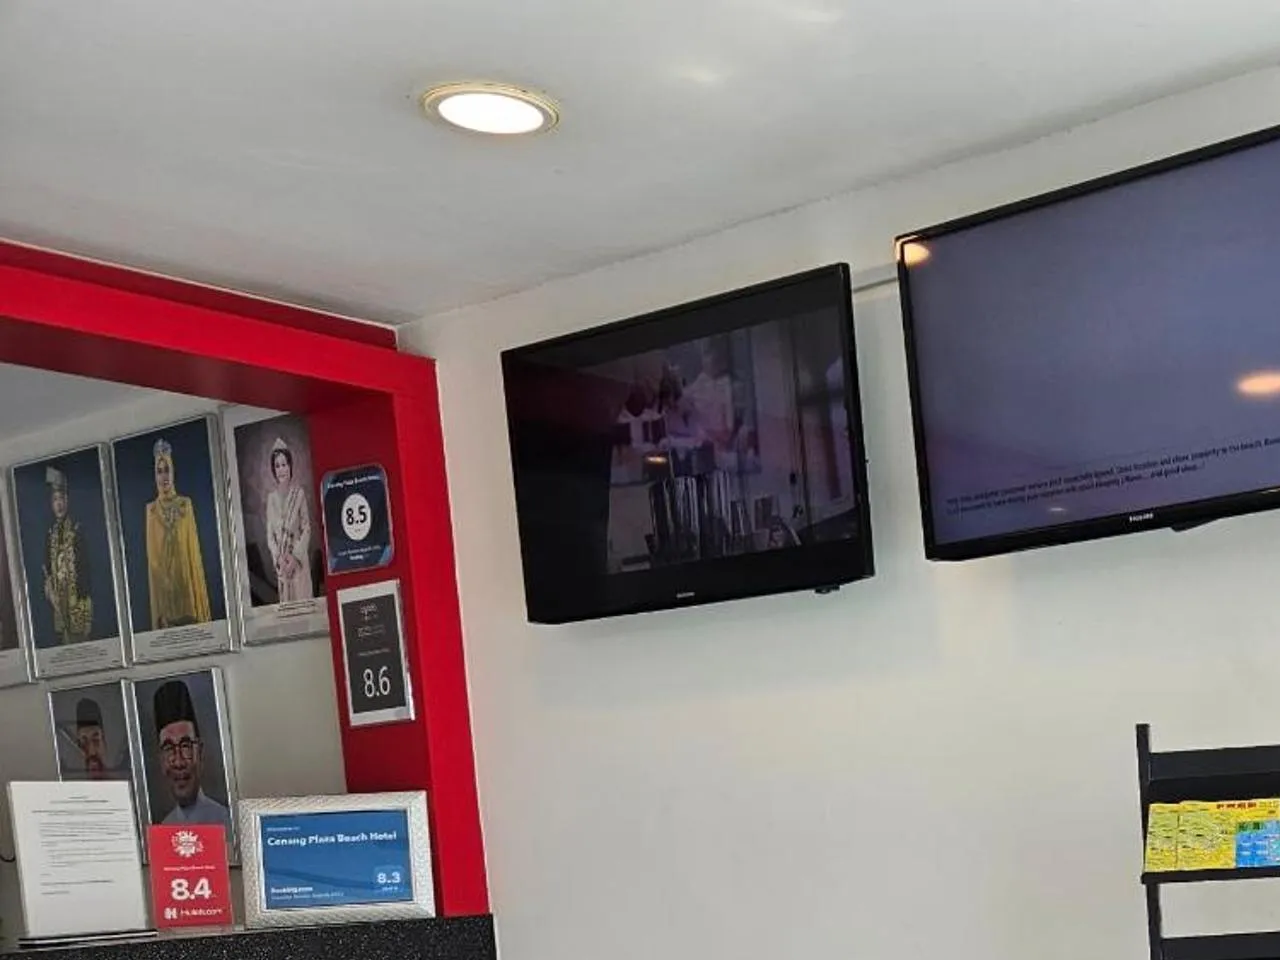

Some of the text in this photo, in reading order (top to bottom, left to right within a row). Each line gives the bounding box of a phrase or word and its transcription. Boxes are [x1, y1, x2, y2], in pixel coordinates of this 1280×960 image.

[345, 504, 368, 526] 8.5
[362, 665, 391, 698] 8.6
[267, 836, 307, 847] Cenang
[337, 832, 368, 843] Beach
[369, 830, 397, 841] Hotel
[171, 876, 213, 901] 8.4
[376, 871, 401, 884] 8.3
